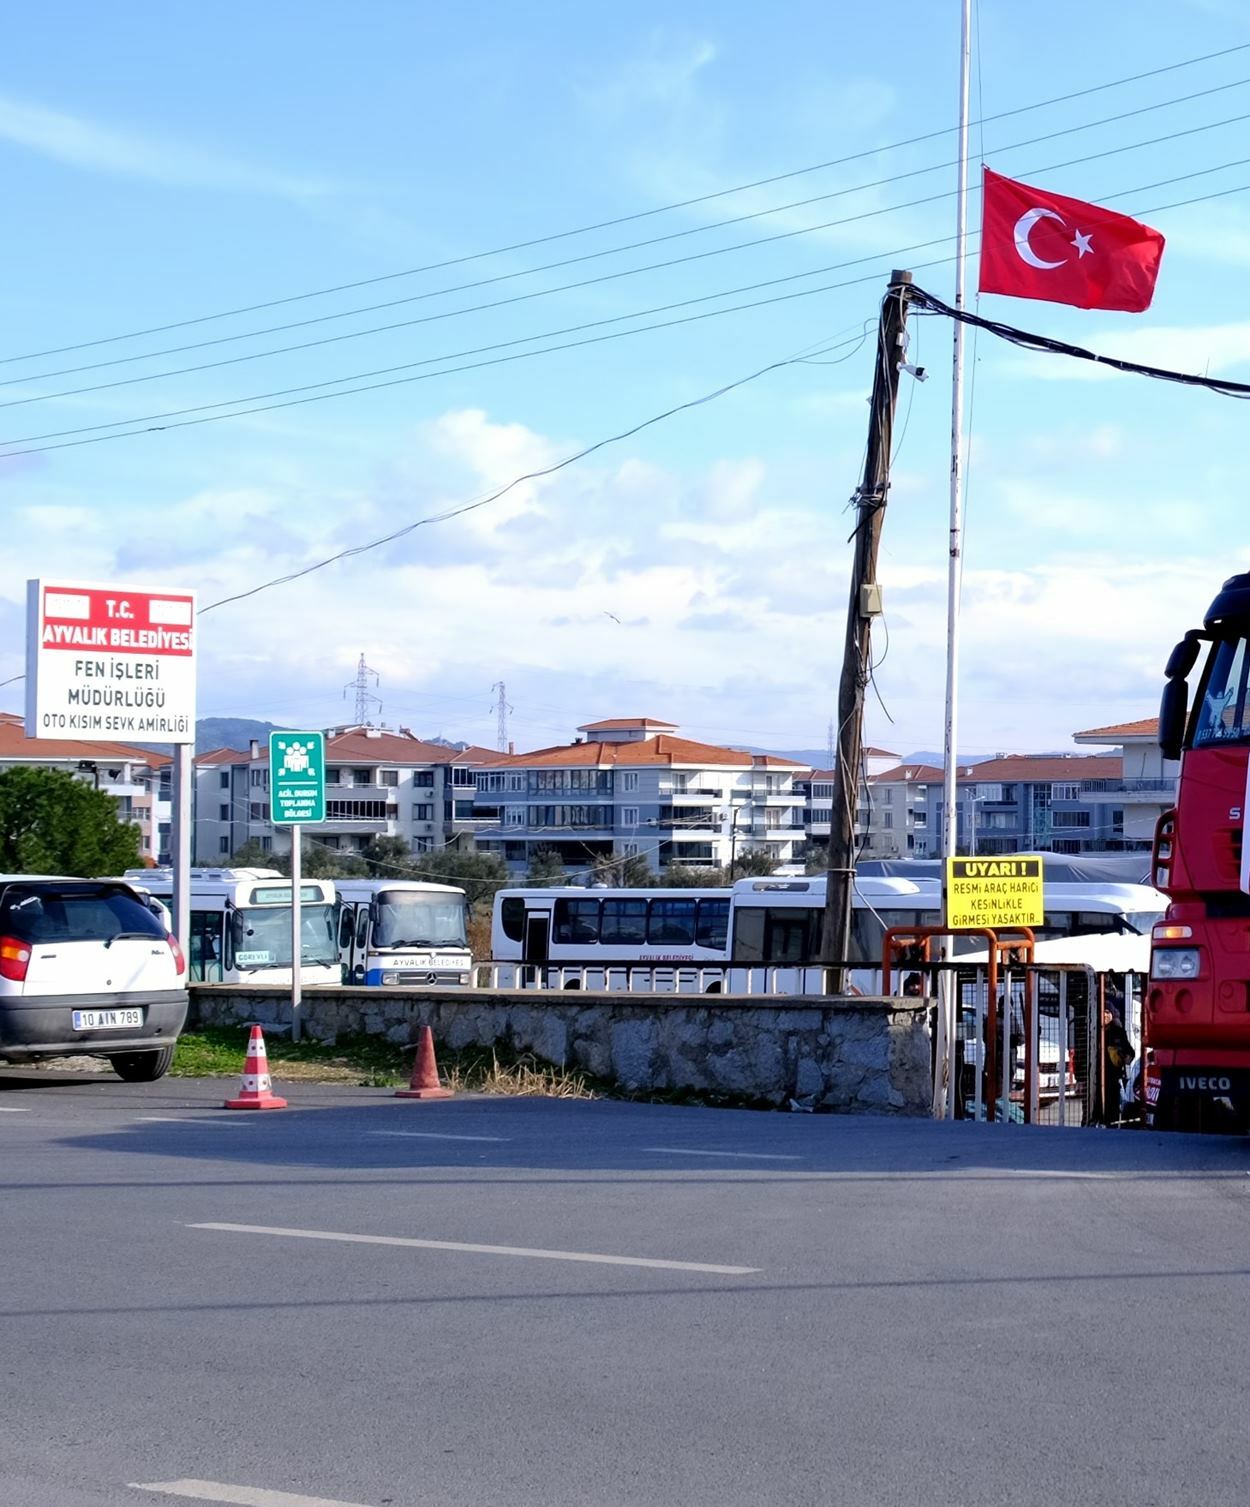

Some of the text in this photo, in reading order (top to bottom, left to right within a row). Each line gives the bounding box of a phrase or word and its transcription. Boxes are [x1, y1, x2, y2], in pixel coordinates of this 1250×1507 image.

[106, 599, 134, 619] T.C.
[43, 624, 193, 650] AYVALIK BELEDİYESİ
[75, 657, 159, 680] FEN İŞLERİ
[68, 684, 165, 708] MÜDÜRLÜĞÜ
[43, 713, 189, 733] OTO KISIM SEVK AMİRLİĞİ
[965, 862, 1017, 876] UYARI
[984, 882, 1007, 894] ARAÇ
[971, 898, 1023, 910] KESİNLİKLE
[82, 1011, 139, 1026] 10 AIN 789
[1179, 1077, 1231, 1090] IVECO
